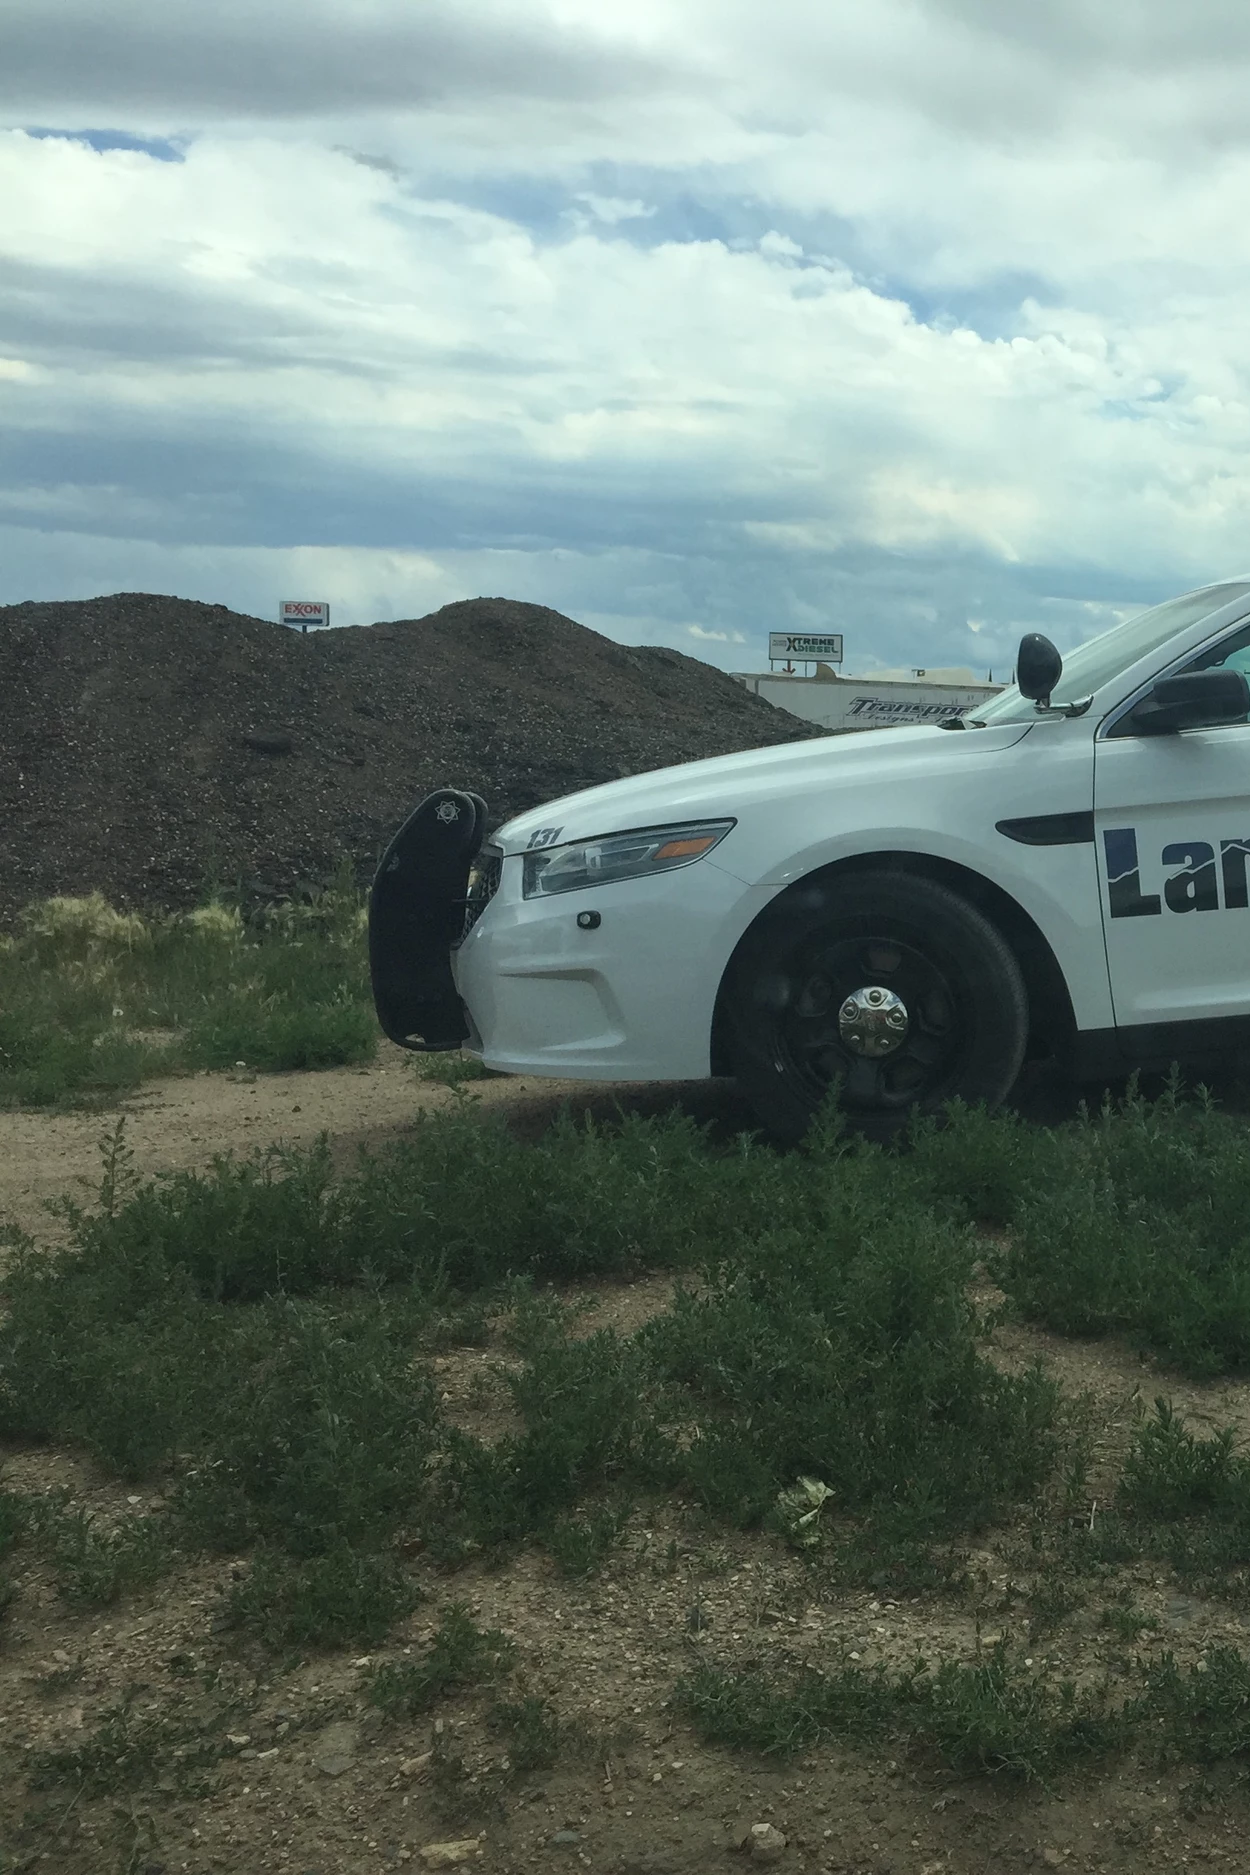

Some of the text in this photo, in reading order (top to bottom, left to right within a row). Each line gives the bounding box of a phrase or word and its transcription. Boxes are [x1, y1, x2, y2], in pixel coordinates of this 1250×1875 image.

[284, 603, 322, 617] EXXON
[786, 637, 835, 652] XTREME
[797, 645, 839, 654] DIESEL
[847, 697, 977, 718] Transpor
[526, 825, 566, 849] 131
